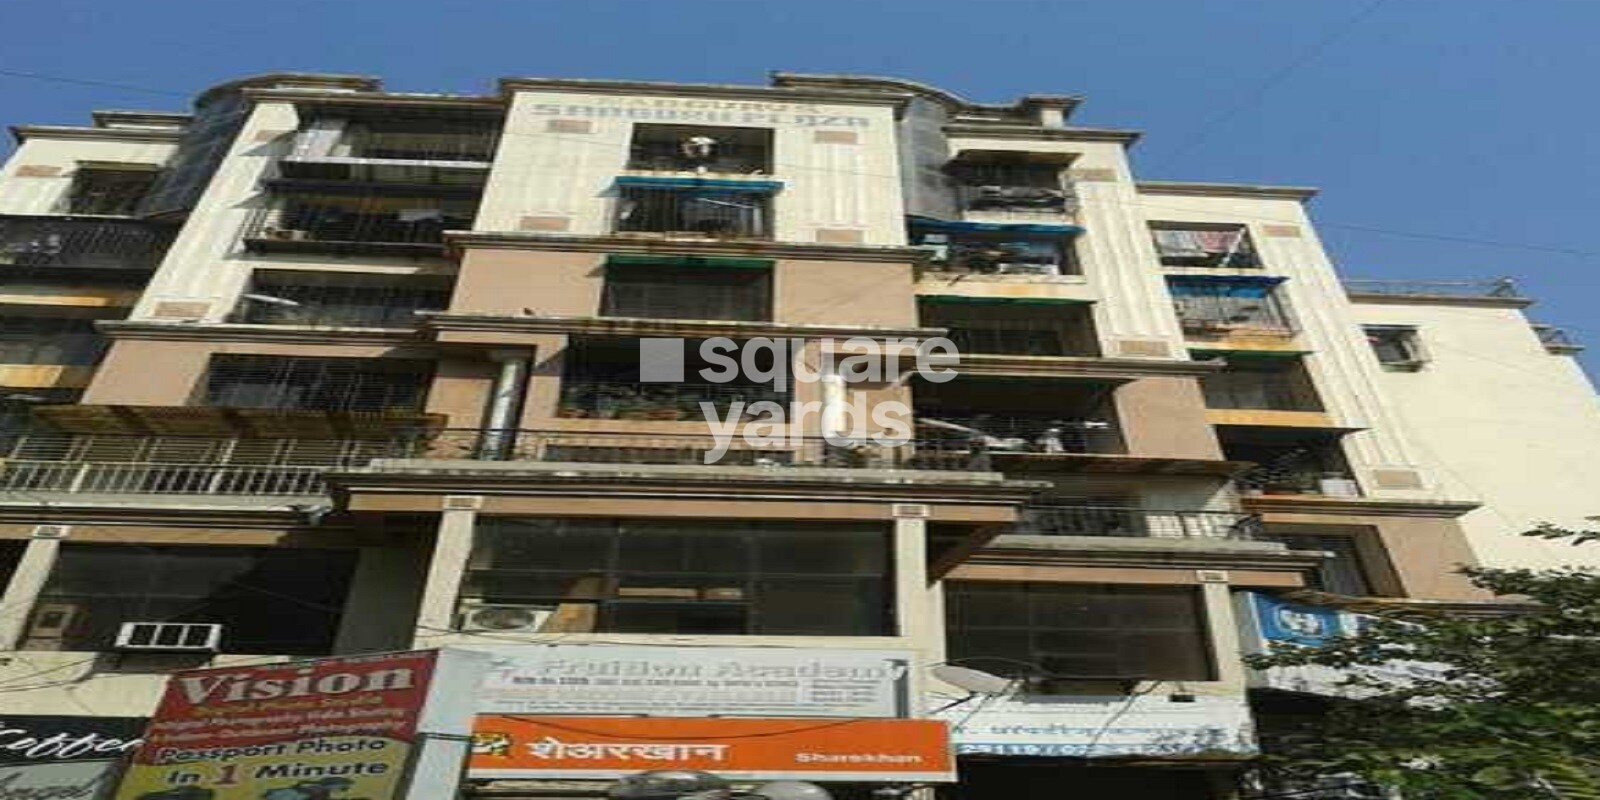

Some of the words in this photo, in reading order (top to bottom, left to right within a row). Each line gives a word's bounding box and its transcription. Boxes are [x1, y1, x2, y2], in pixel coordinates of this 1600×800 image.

[179, 666, 415, 704] Vision
[160, 743, 287, 763] Passport
[296, 736, 388, 756] Photo
[528, 737, 729, 762] शेअरखान
[795, 750, 923, 764] Sharekhan
[166, 769, 201, 786] In
[214, 764, 240, 786] 1
[255, 758, 389, 781] Minute
